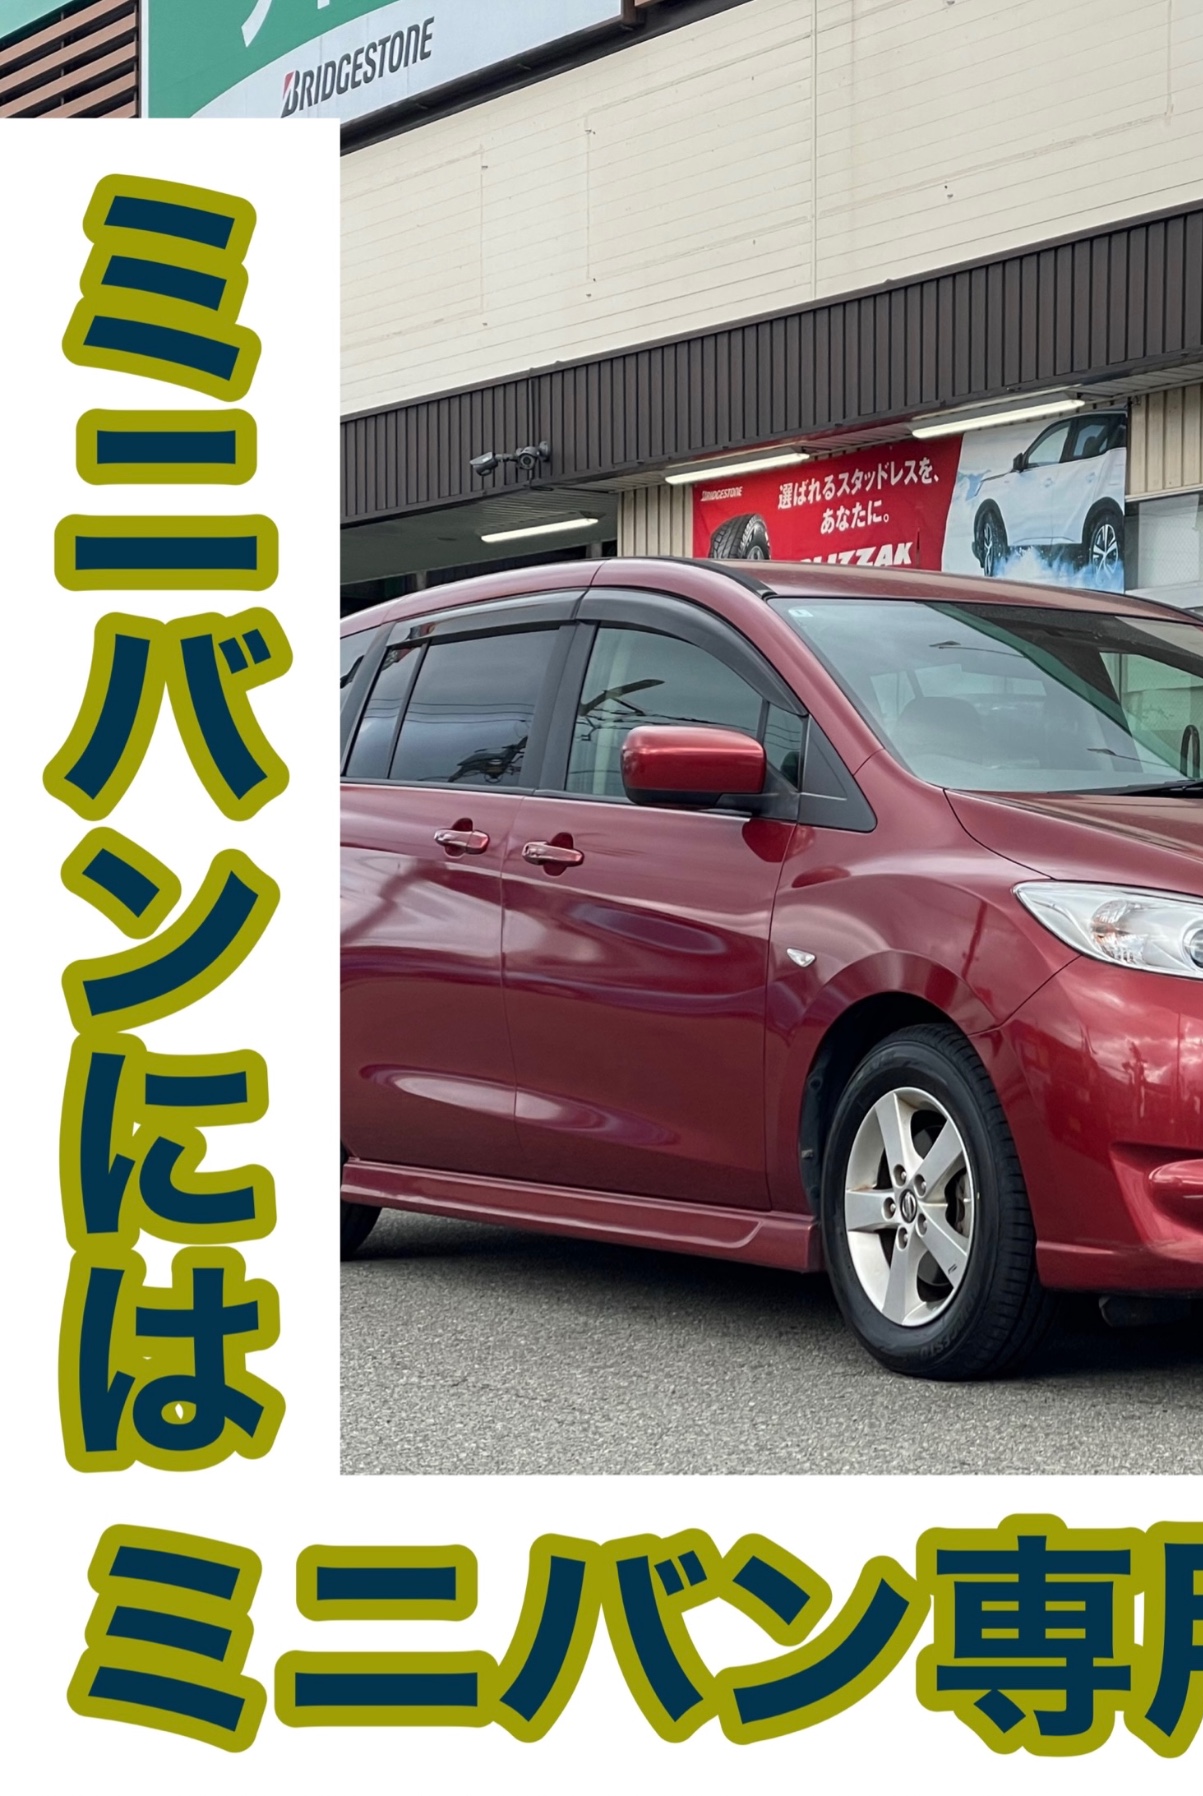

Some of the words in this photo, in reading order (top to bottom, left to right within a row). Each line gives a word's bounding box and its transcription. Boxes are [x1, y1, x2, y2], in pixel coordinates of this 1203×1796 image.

[280, 16, 435, 118] BRIDGESTONE
[700, 485, 743, 502] BRIDGESTONE
[777, 457, 940, 510] 選ばれるスタッドレスを、
[819, 499, 890, 535] あなたに。
[799, 541, 914, 567] ZZAK
